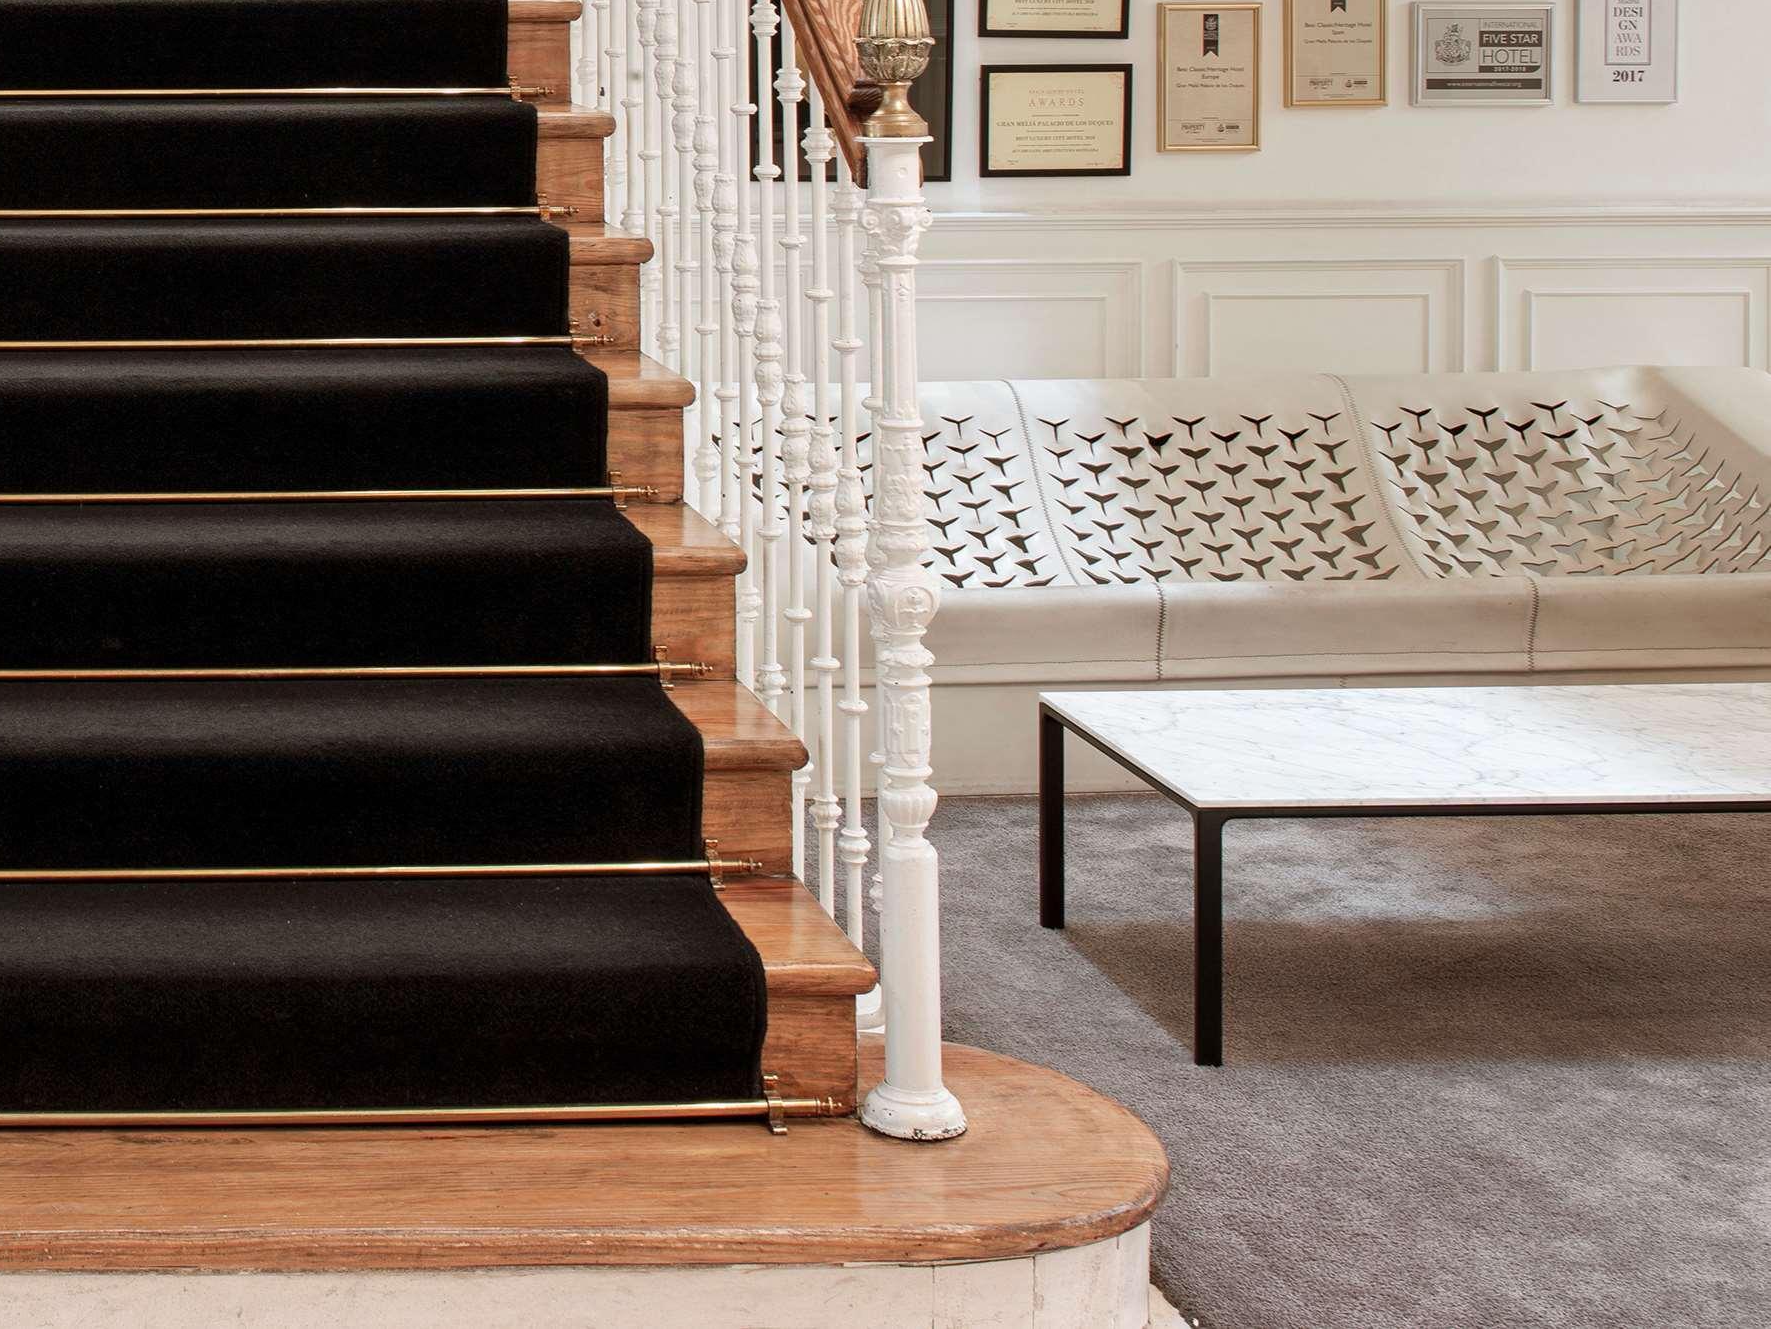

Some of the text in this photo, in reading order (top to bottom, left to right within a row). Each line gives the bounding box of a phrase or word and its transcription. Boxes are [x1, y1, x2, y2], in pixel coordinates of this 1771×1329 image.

[1614, 7, 1643, 17] DESI
[1484, 21, 1538, 29] INTERNATIONAL
[1618, 20, 1637, 30] GN
[1483, 34, 1538, 44] FIVE STAR
[1614, 33, 1642, 43] AWA
[1616, 46, 1641, 56] RDS
[1482, 49, 1538, 64] HOTEL
[1612, 70, 1644, 82] 2017
[1029, 98, 1084, 107] AWARDS
